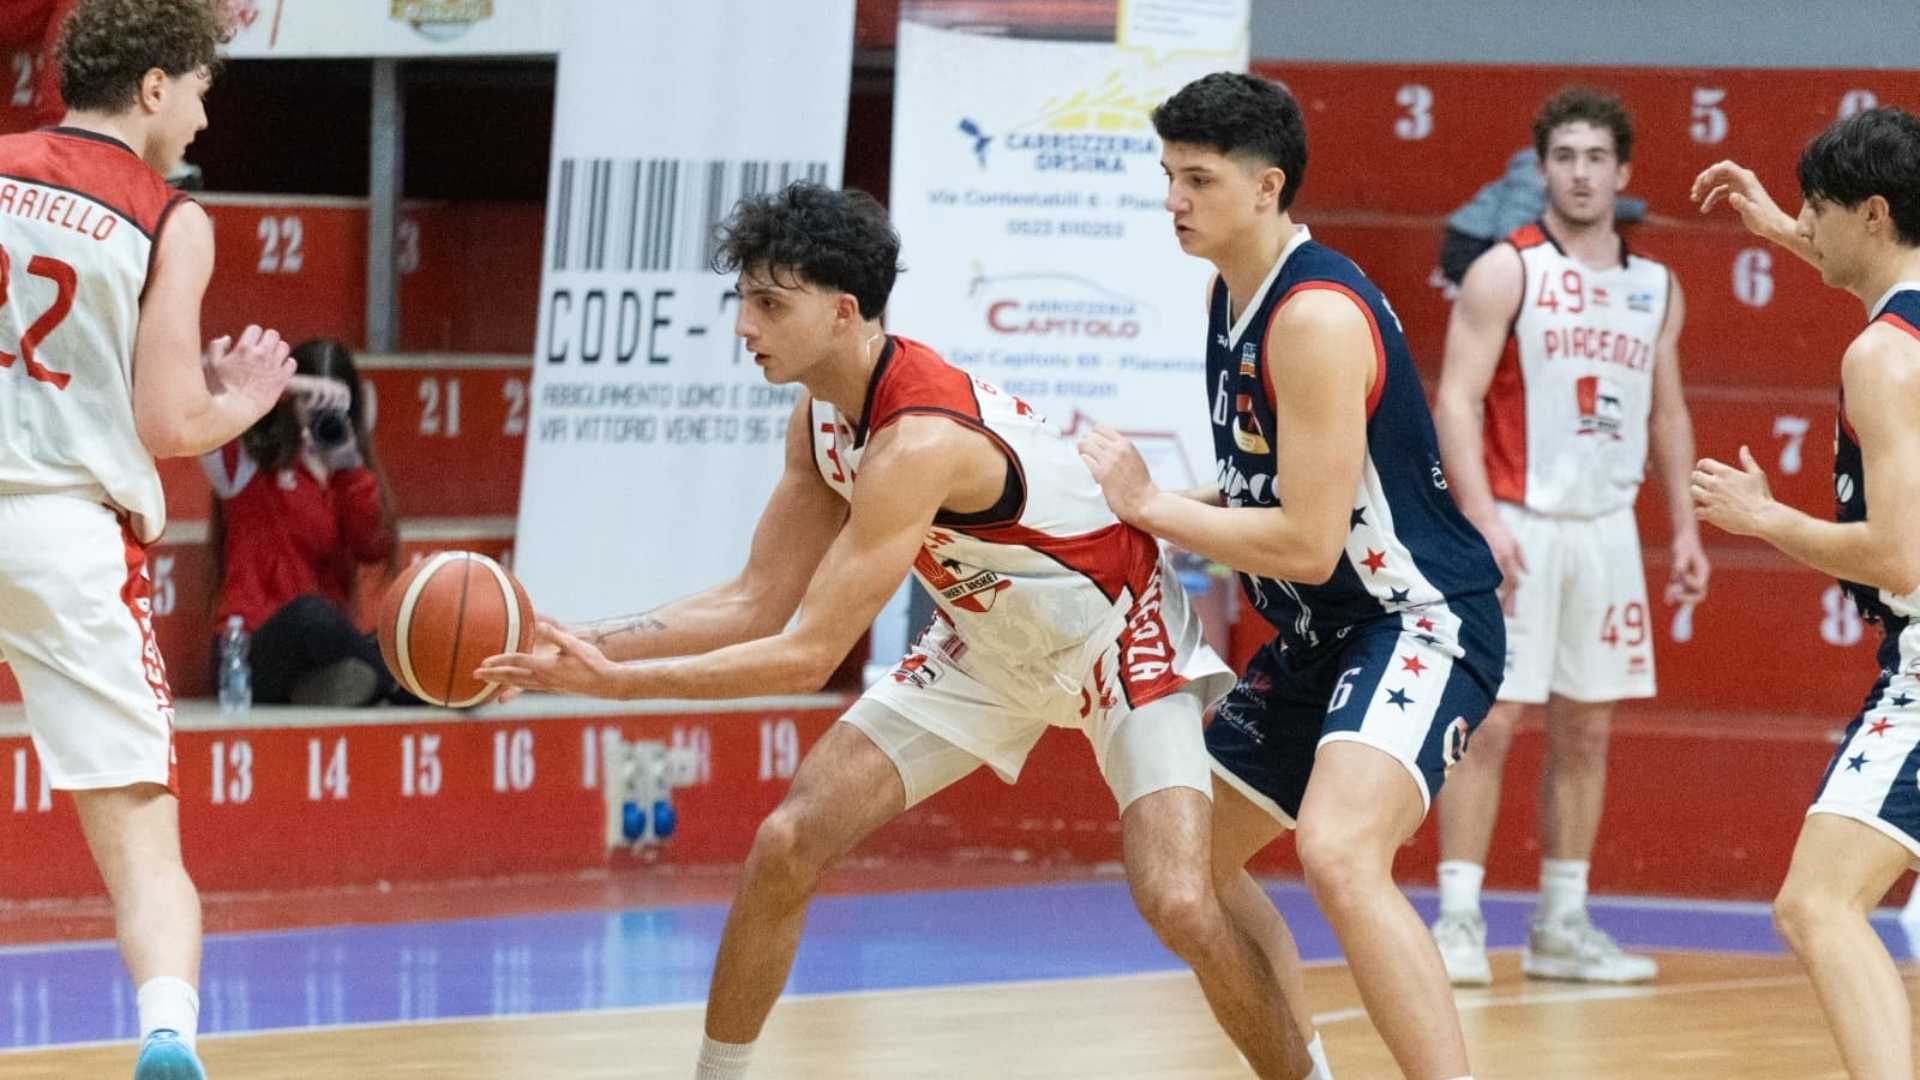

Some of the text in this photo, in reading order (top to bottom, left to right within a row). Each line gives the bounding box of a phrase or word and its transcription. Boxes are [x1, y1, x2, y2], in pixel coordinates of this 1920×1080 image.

[1395, 84, 1433, 141] 3
[1689, 88, 1728, 144] 5
[1006, 133, 1157, 153] CARROZZERIA
[1035, 154, 1126, 173] ORSINA
[256, 215, 305, 273] 22
[1536, 269, 1586, 314] 49
[1733, 248, 1774, 307] 6
[986, 300, 1140, 338] CAPITOLO
[419, 376, 461, 437] 21
[503, 377, 528, 436] 2
[1212, 369, 1229, 426] 6
[1774, 416, 1811, 474] 7
[153, 555, 176, 616] 5
[1600, 602, 1646, 647] 49
[1820, 585, 1863, 646] 8
[1327, 666, 1363, 714] 6
[211, 740, 254, 804] 13
[307, 736, 351, 800] 14
[400, 733, 443, 797] 15
[493, 728, 536, 792] 16
[758, 717, 799, 781] 19
